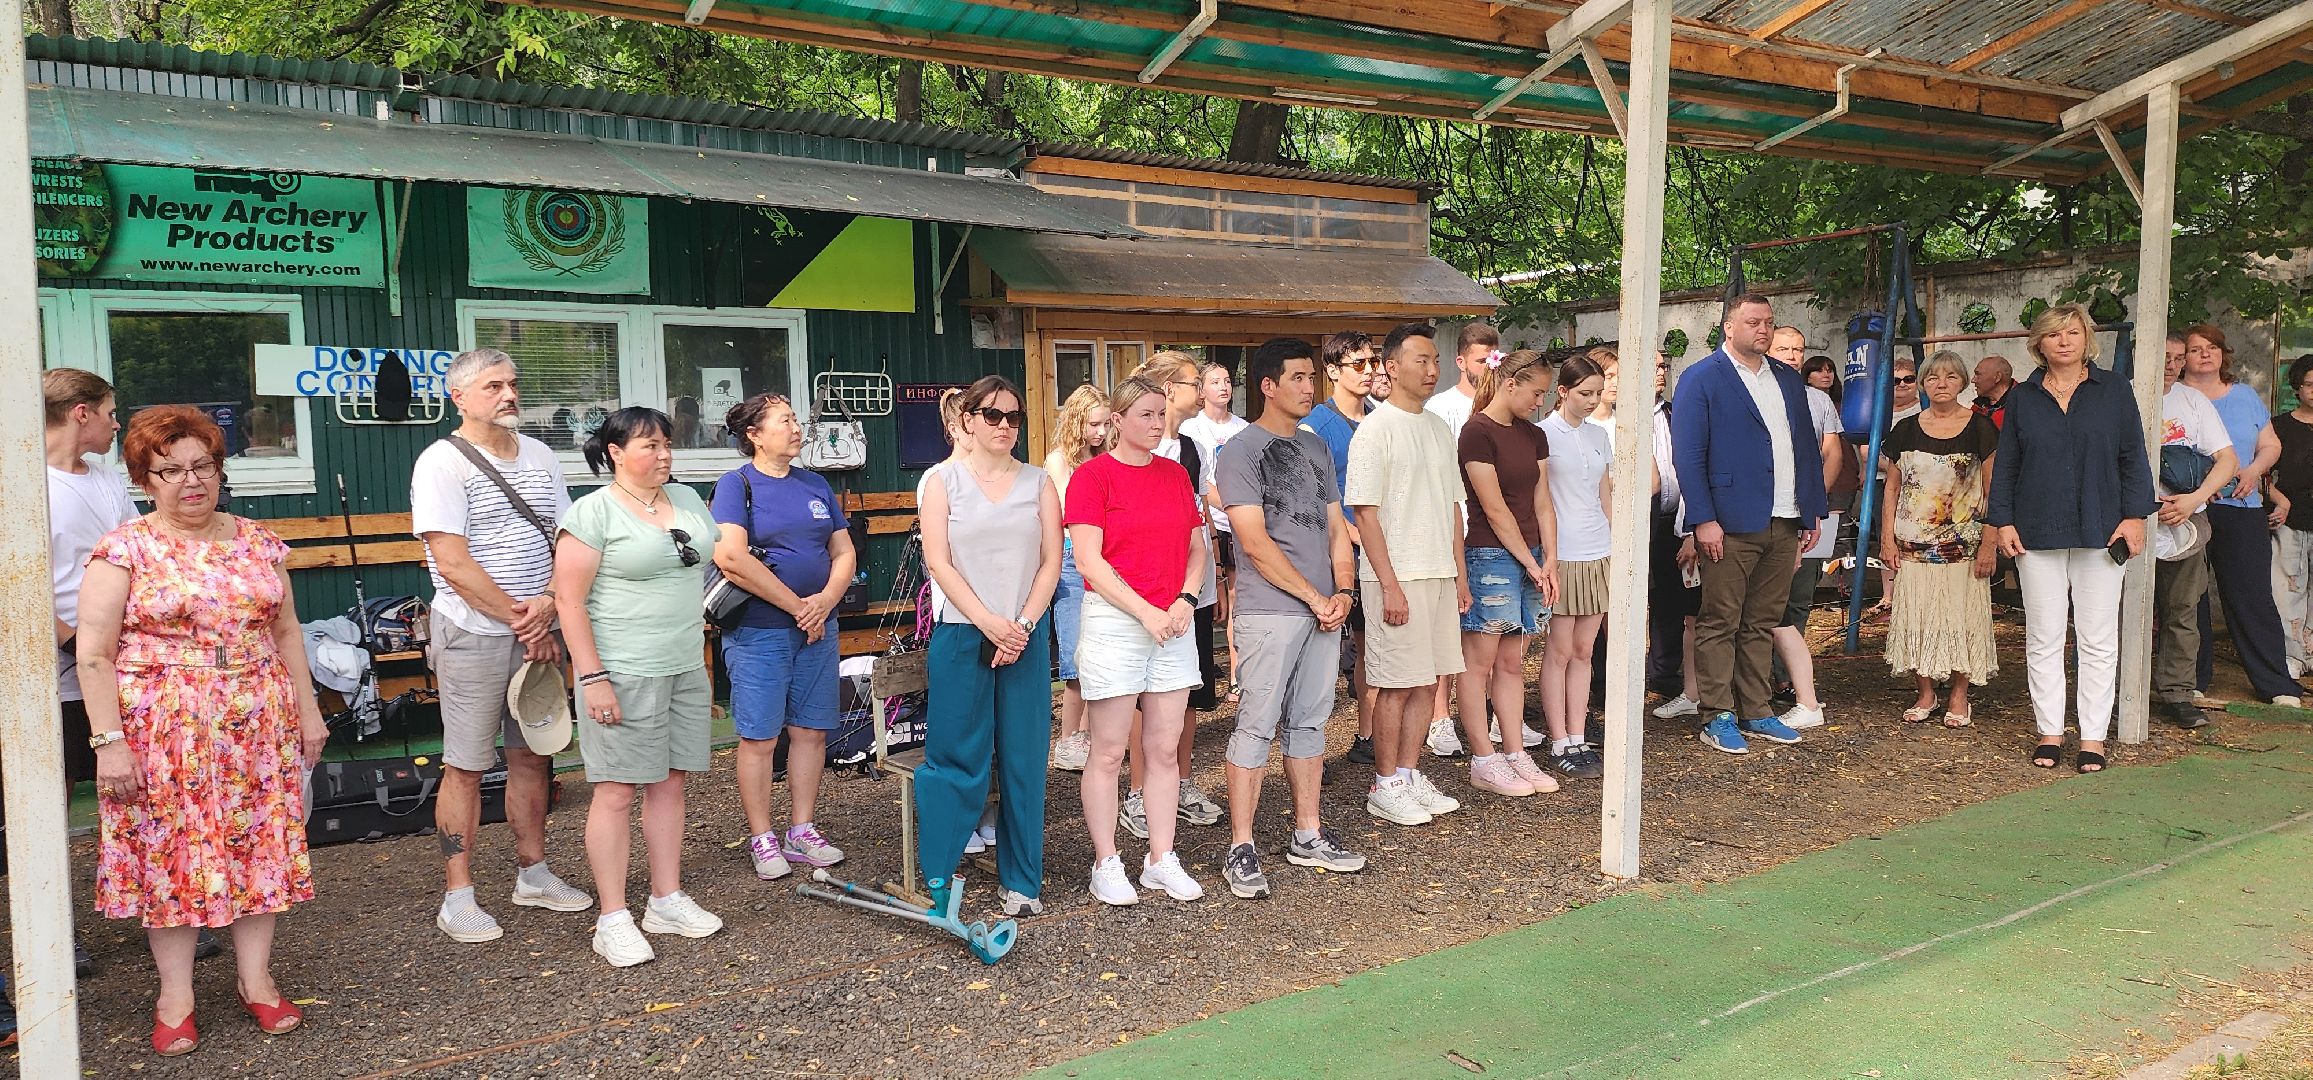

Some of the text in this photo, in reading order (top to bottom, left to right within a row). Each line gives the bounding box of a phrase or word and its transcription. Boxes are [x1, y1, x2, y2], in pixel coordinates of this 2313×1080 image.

[128, 193, 368, 233] New Archery
[35, 228, 80, 241] IZERS
[167, 223, 335, 253] Products
[140, 259, 361, 276] www.newarchery.com
[314, 346, 453, 375] DOPNG
